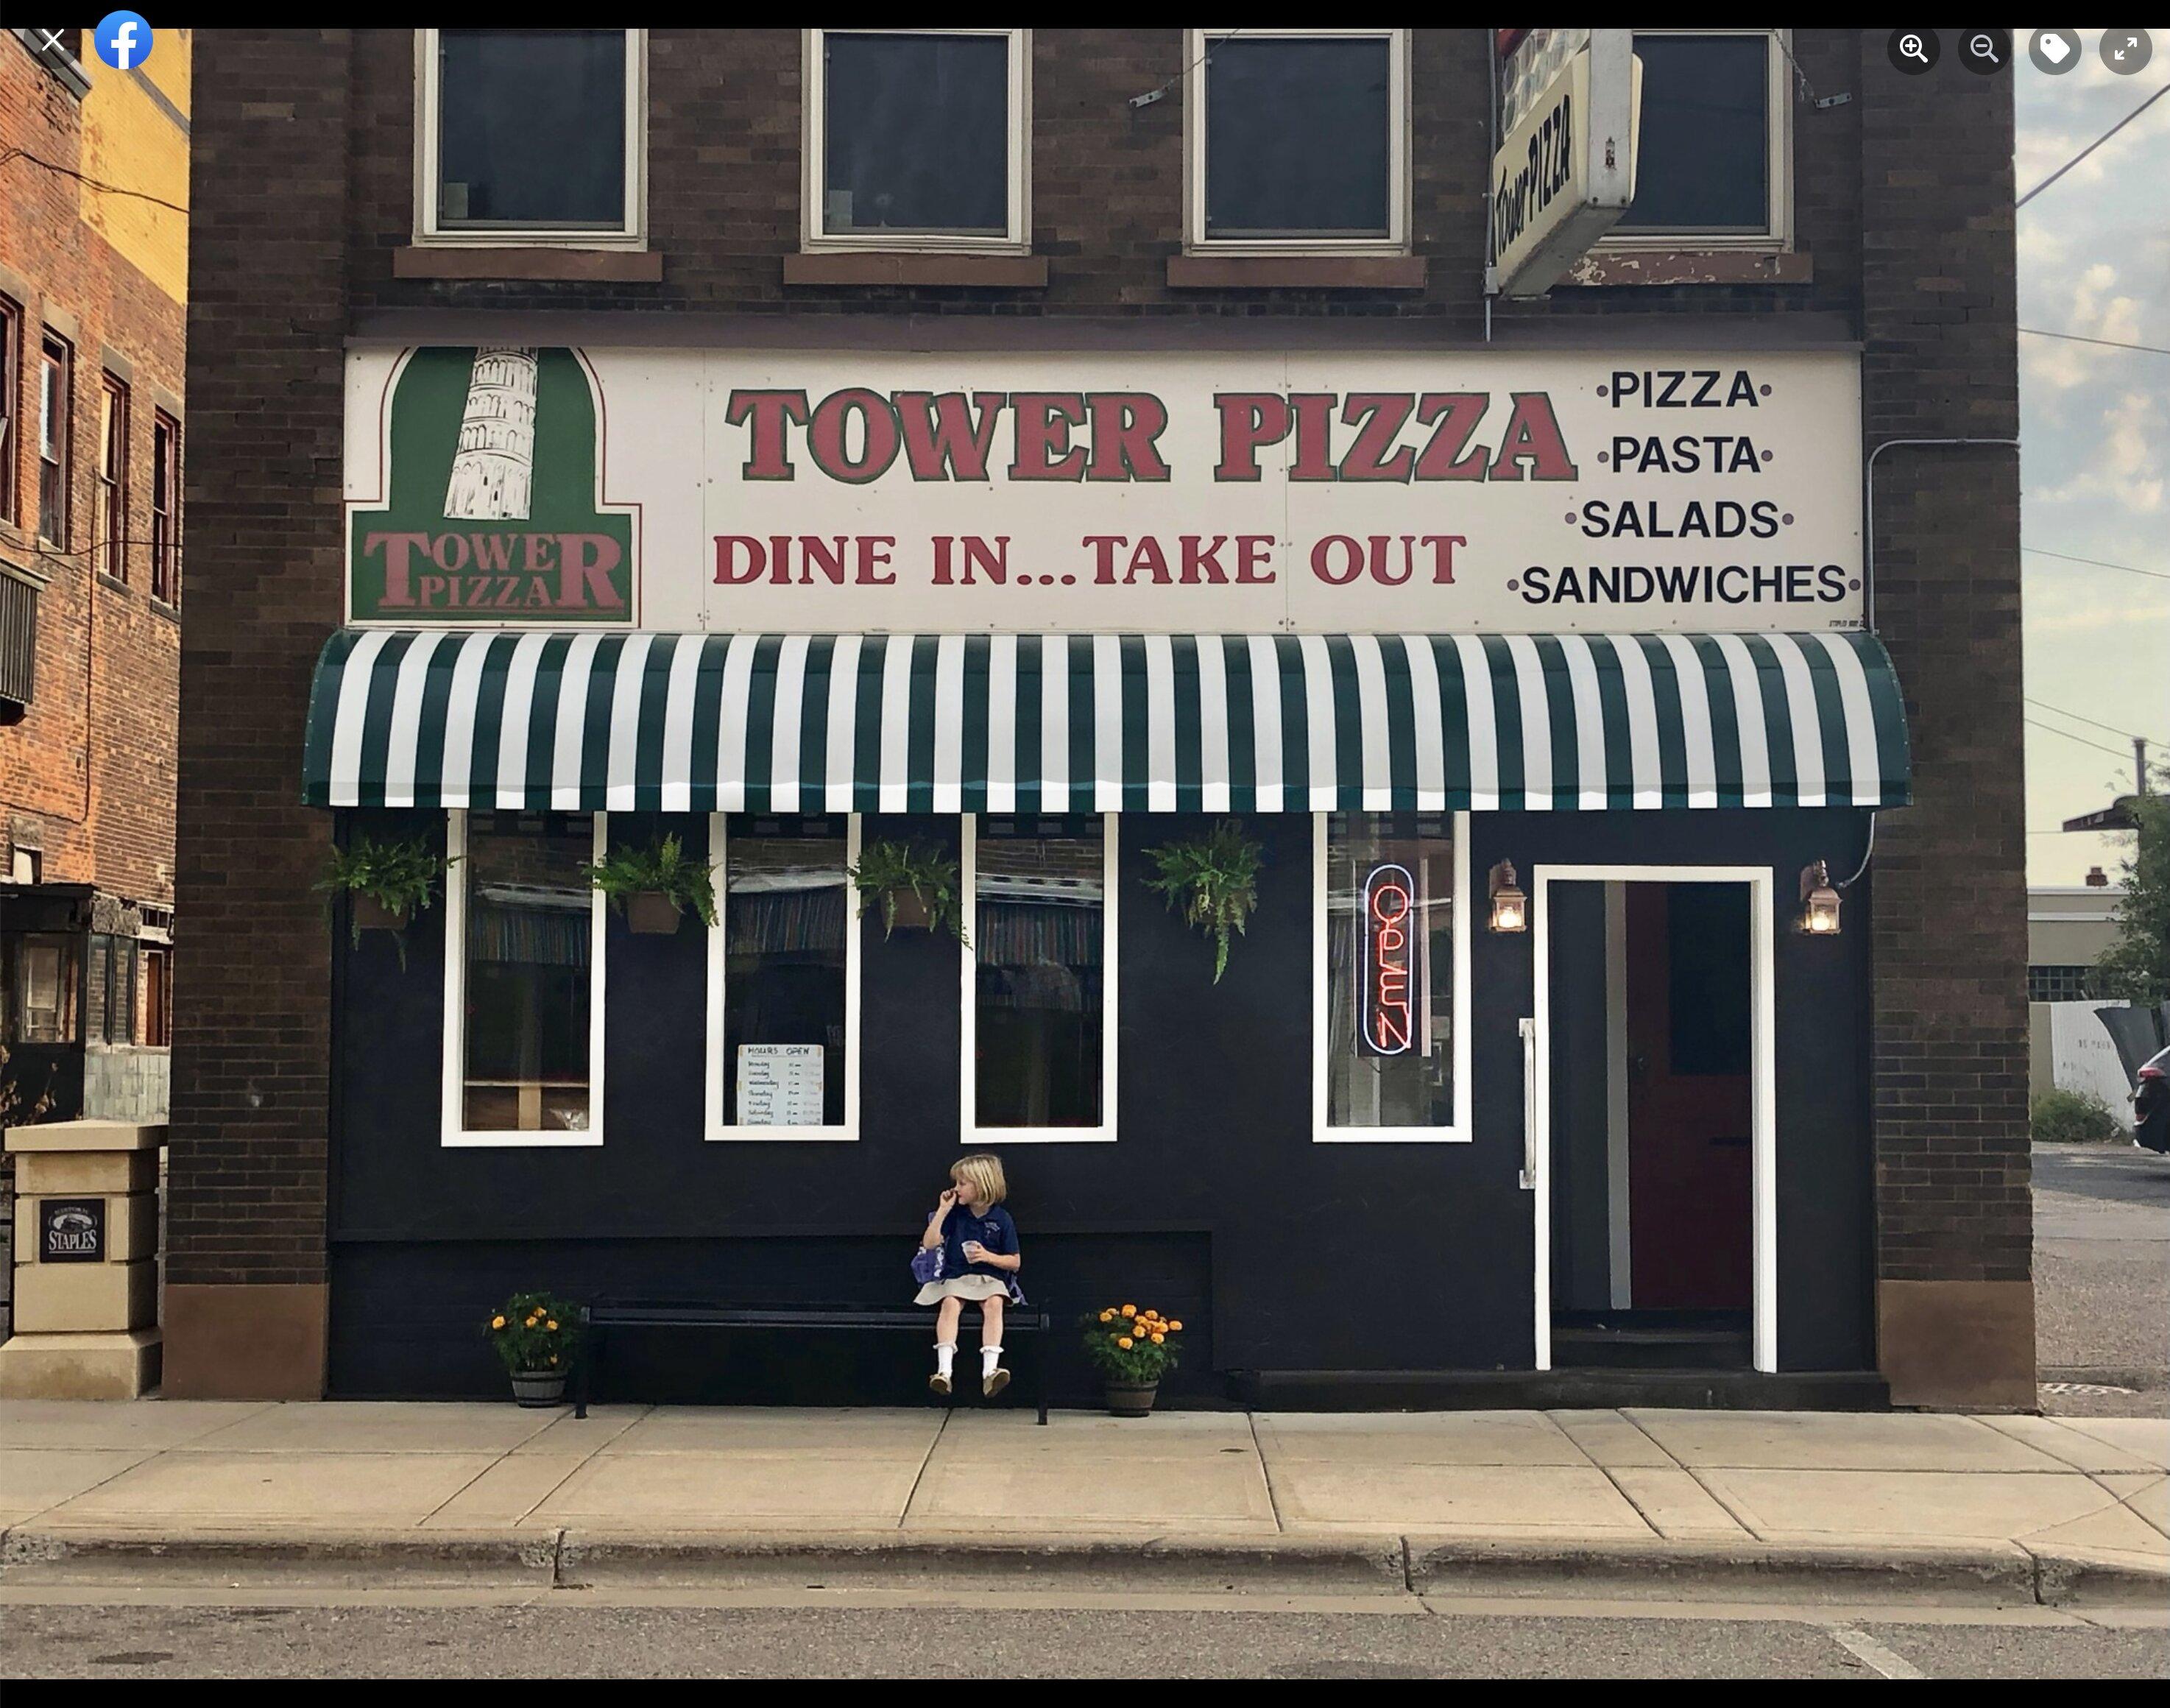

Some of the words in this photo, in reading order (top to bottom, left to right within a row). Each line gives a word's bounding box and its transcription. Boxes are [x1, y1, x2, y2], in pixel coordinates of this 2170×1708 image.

[1495, 165, 1529, 258] Tower
[1528, 93, 1571, 222] PIZZA
[1612, 370, 1759, 408] PIZZA
[724, 387, 1172, 485] TOWER
[1212, 390, 1579, 486] PIZZA
[1613, 436, 1761, 473] PASTA
[1581, 500, 1778, 538] SALADS
[364, 532, 624, 607] TOWER
[713, 535, 897, 585] DINE
[1310, 534, 1467, 586] OUT
[419, 575, 552, 607] PIZZA
[1522, 565, 1846, 604] SANDWICHES
[1373, 885, 1412, 1049] OPEN
[748, 1047, 779, 1055] HOURS
[785, 1047, 810, 1055] OPEN
[49, 1229, 96, 1251] STAPLES
